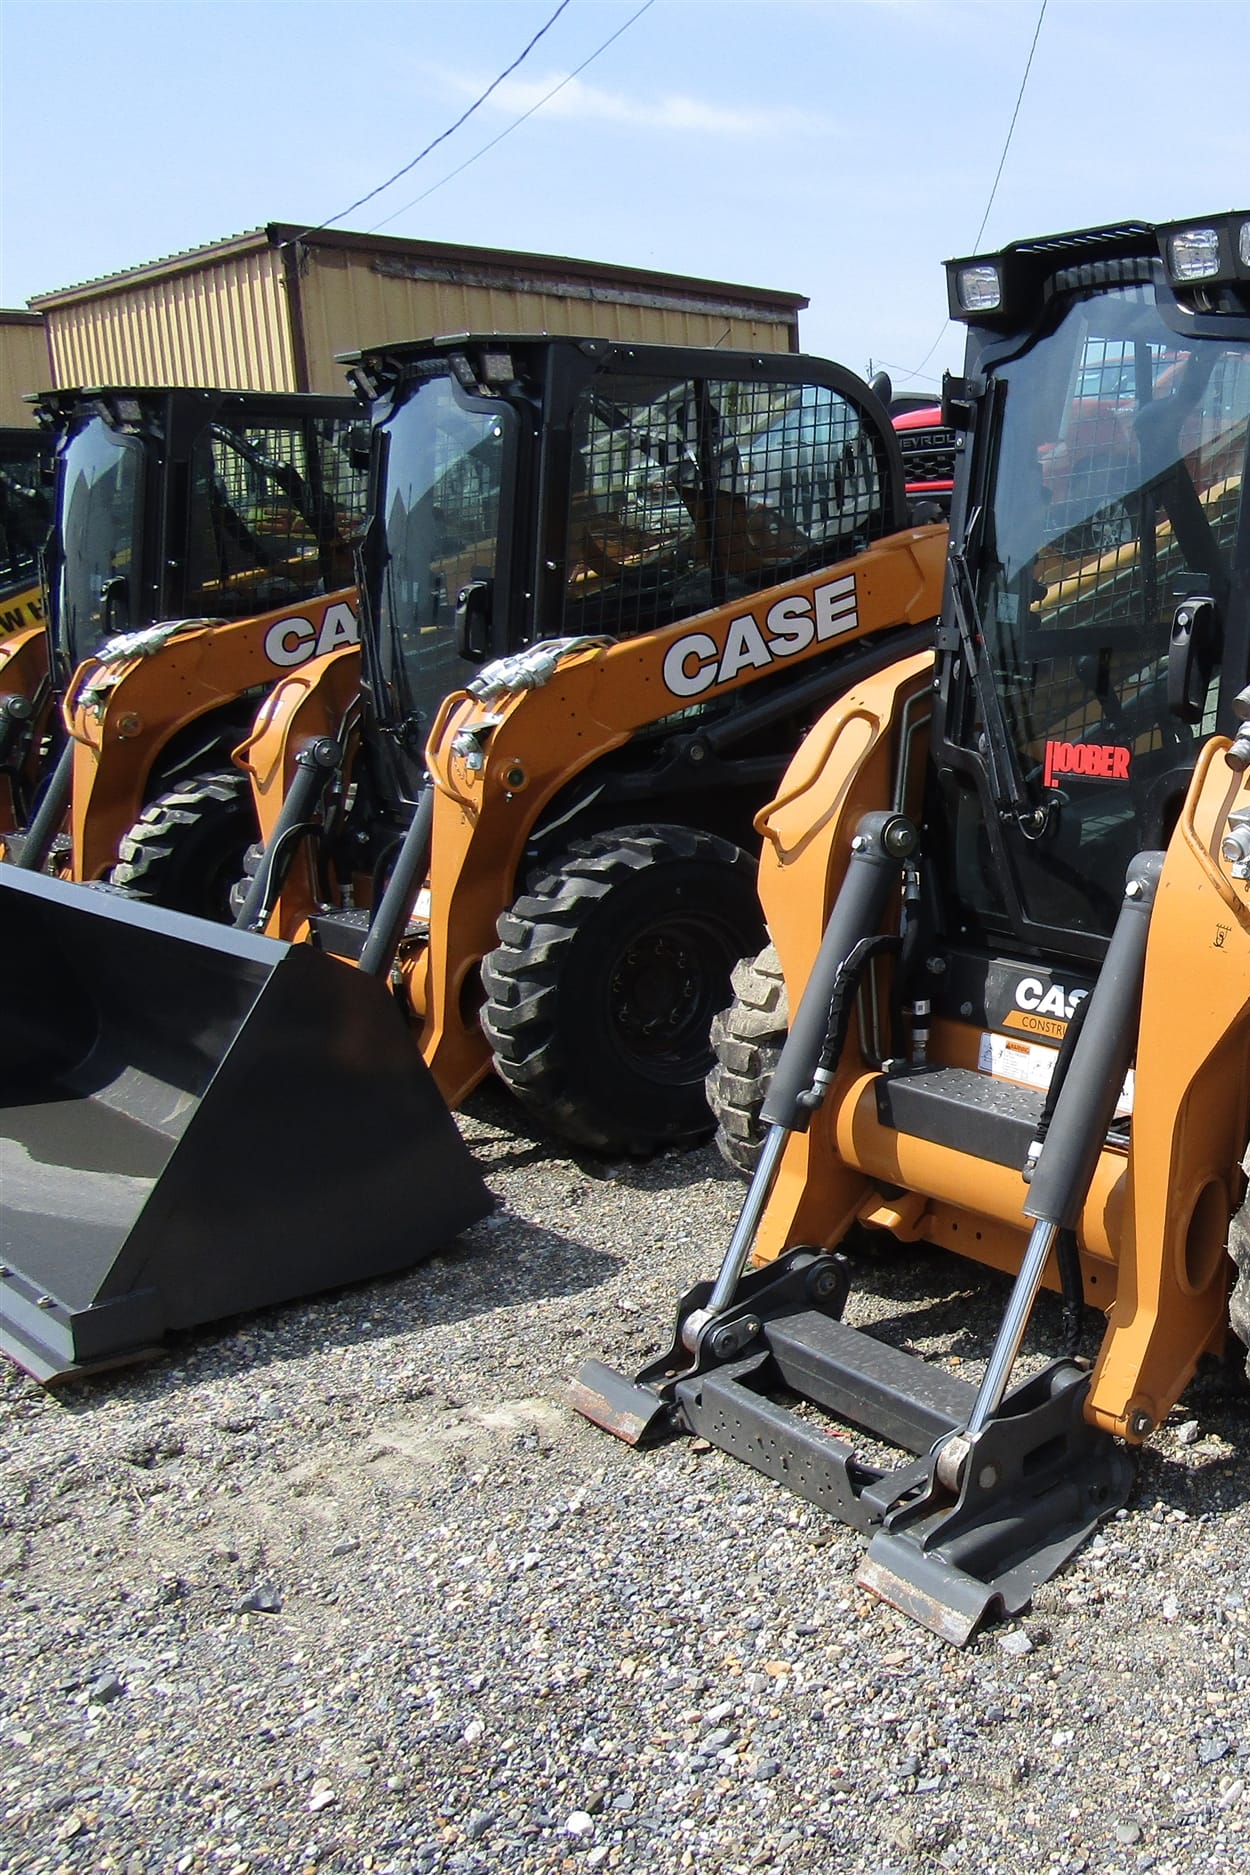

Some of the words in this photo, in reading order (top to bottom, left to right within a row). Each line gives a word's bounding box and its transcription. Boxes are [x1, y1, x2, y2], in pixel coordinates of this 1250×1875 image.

[899, 433, 955, 448] EVROL
[0, 605, 26, 635] W
[264, 601, 361, 668] CA
[662, 572, 859, 698] CASE
[1043, 740, 1131, 788] HOOBER
